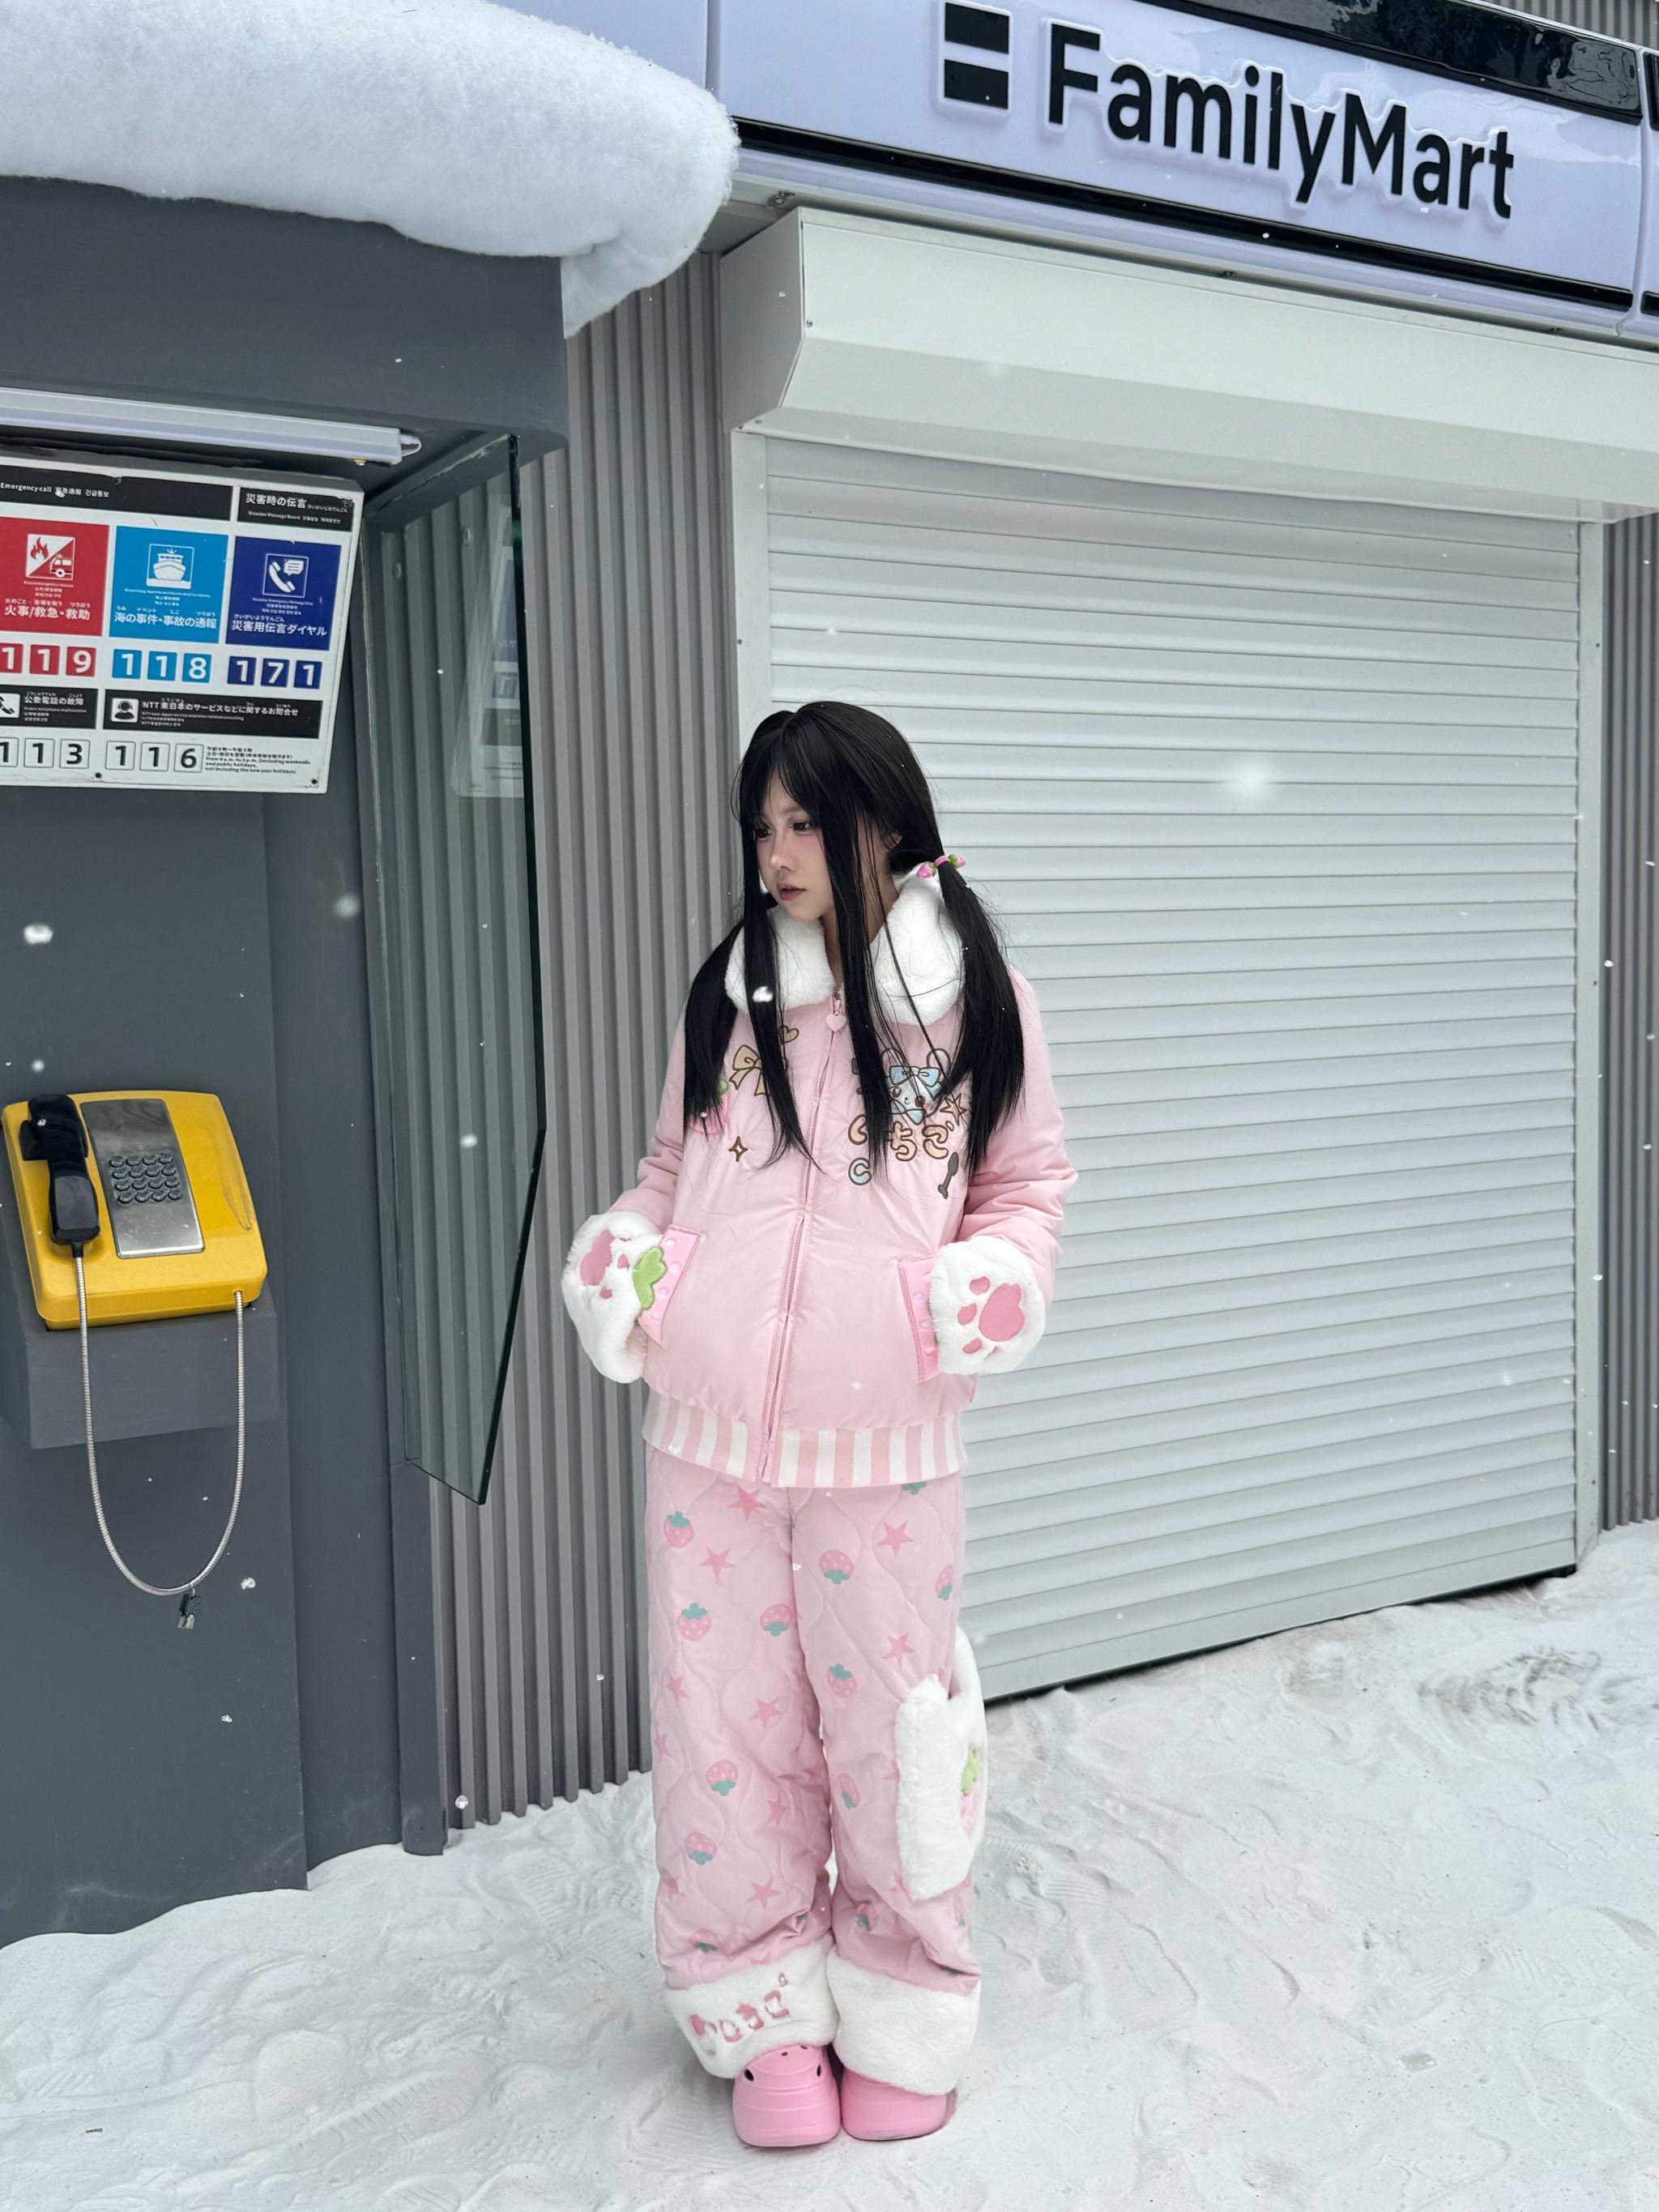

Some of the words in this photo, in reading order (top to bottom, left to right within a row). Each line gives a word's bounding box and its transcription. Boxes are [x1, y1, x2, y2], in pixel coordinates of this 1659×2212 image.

[1049, 23, 1514, 218] FamilyMart
[0, 482, 38, 492] Emergency
[245, 493, 307, 509] 災害時の伝言
[4, 604, 91, 621] 火事/救急・救助
[114, 612, 217, 629] 海の事件・事故の通報
[232, 619, 327, 636] 災害用伝言ダイヤル
[24, 696, 84, 706] 公衆電話の故障
